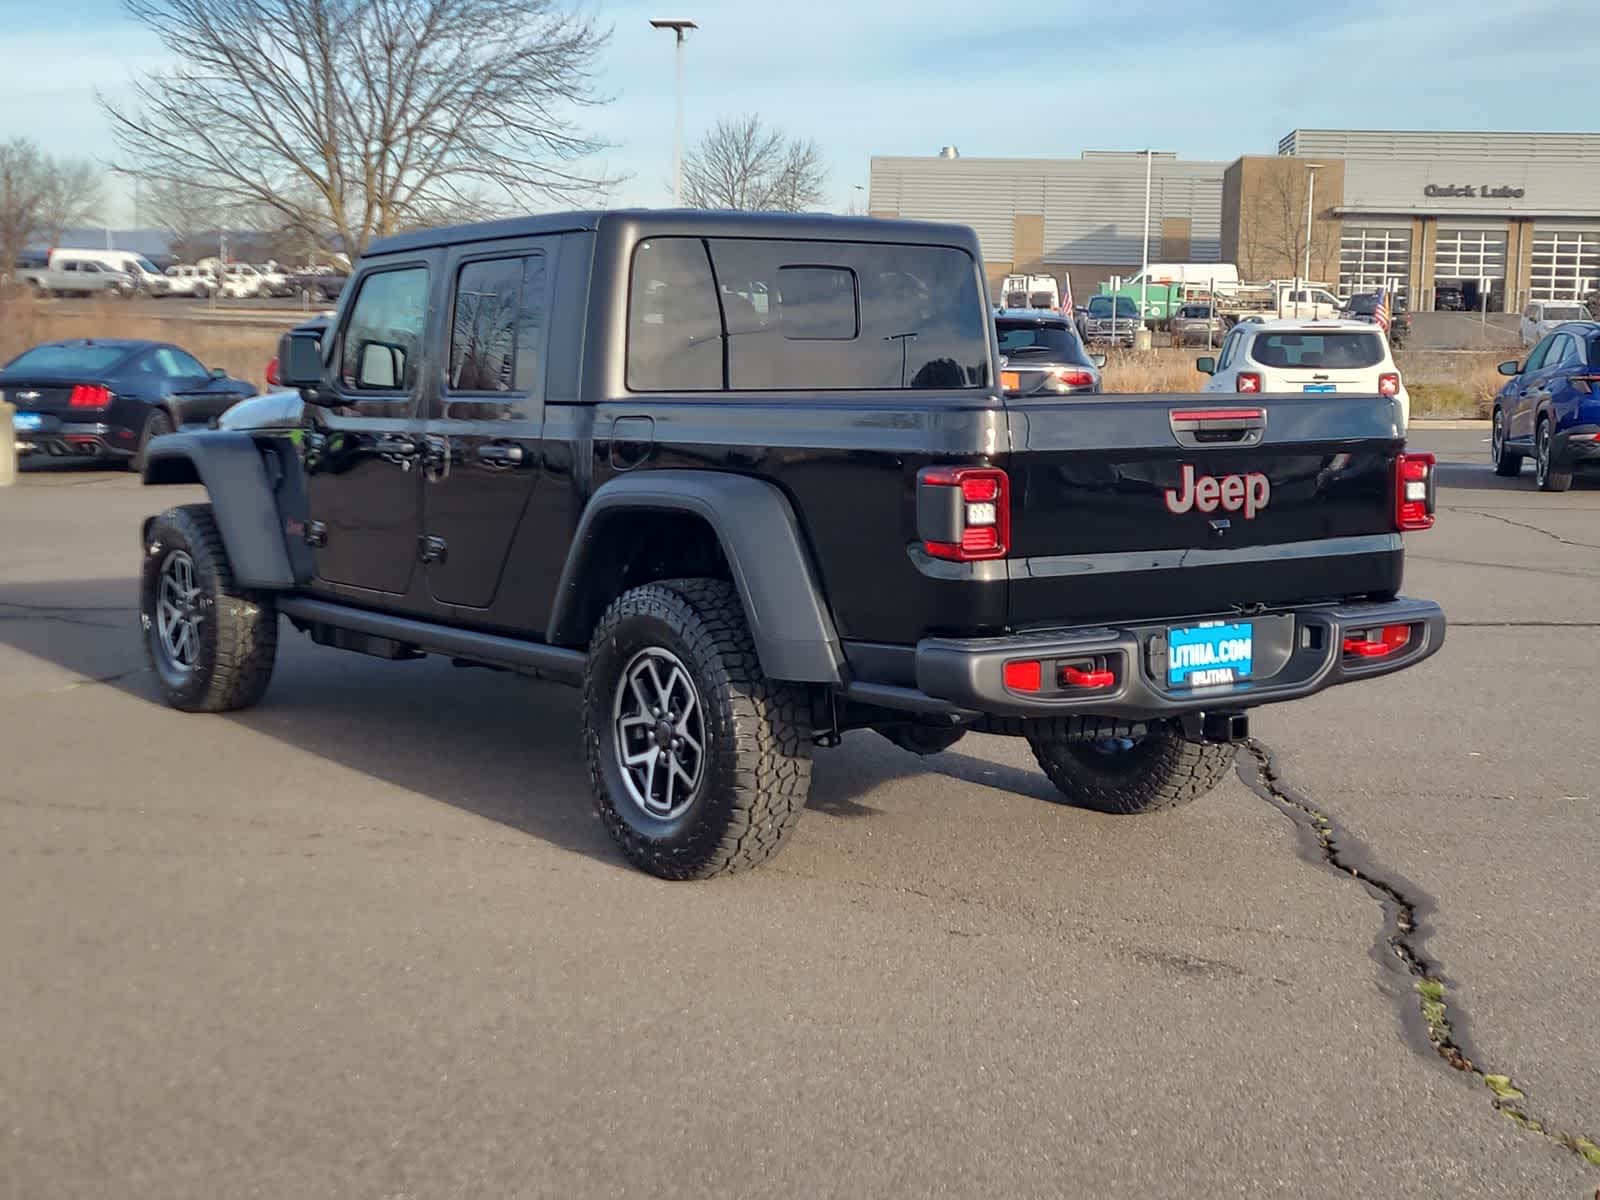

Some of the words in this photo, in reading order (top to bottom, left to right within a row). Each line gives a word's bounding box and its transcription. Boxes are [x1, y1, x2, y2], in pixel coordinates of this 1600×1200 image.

[1424, 184, 1476, 198] Quick
[1481, 184, 1525, 198] Lube
[1165, 464, 1271, 520] Jeep
[1170, 638, 1252, 669] LITHIA.COM
